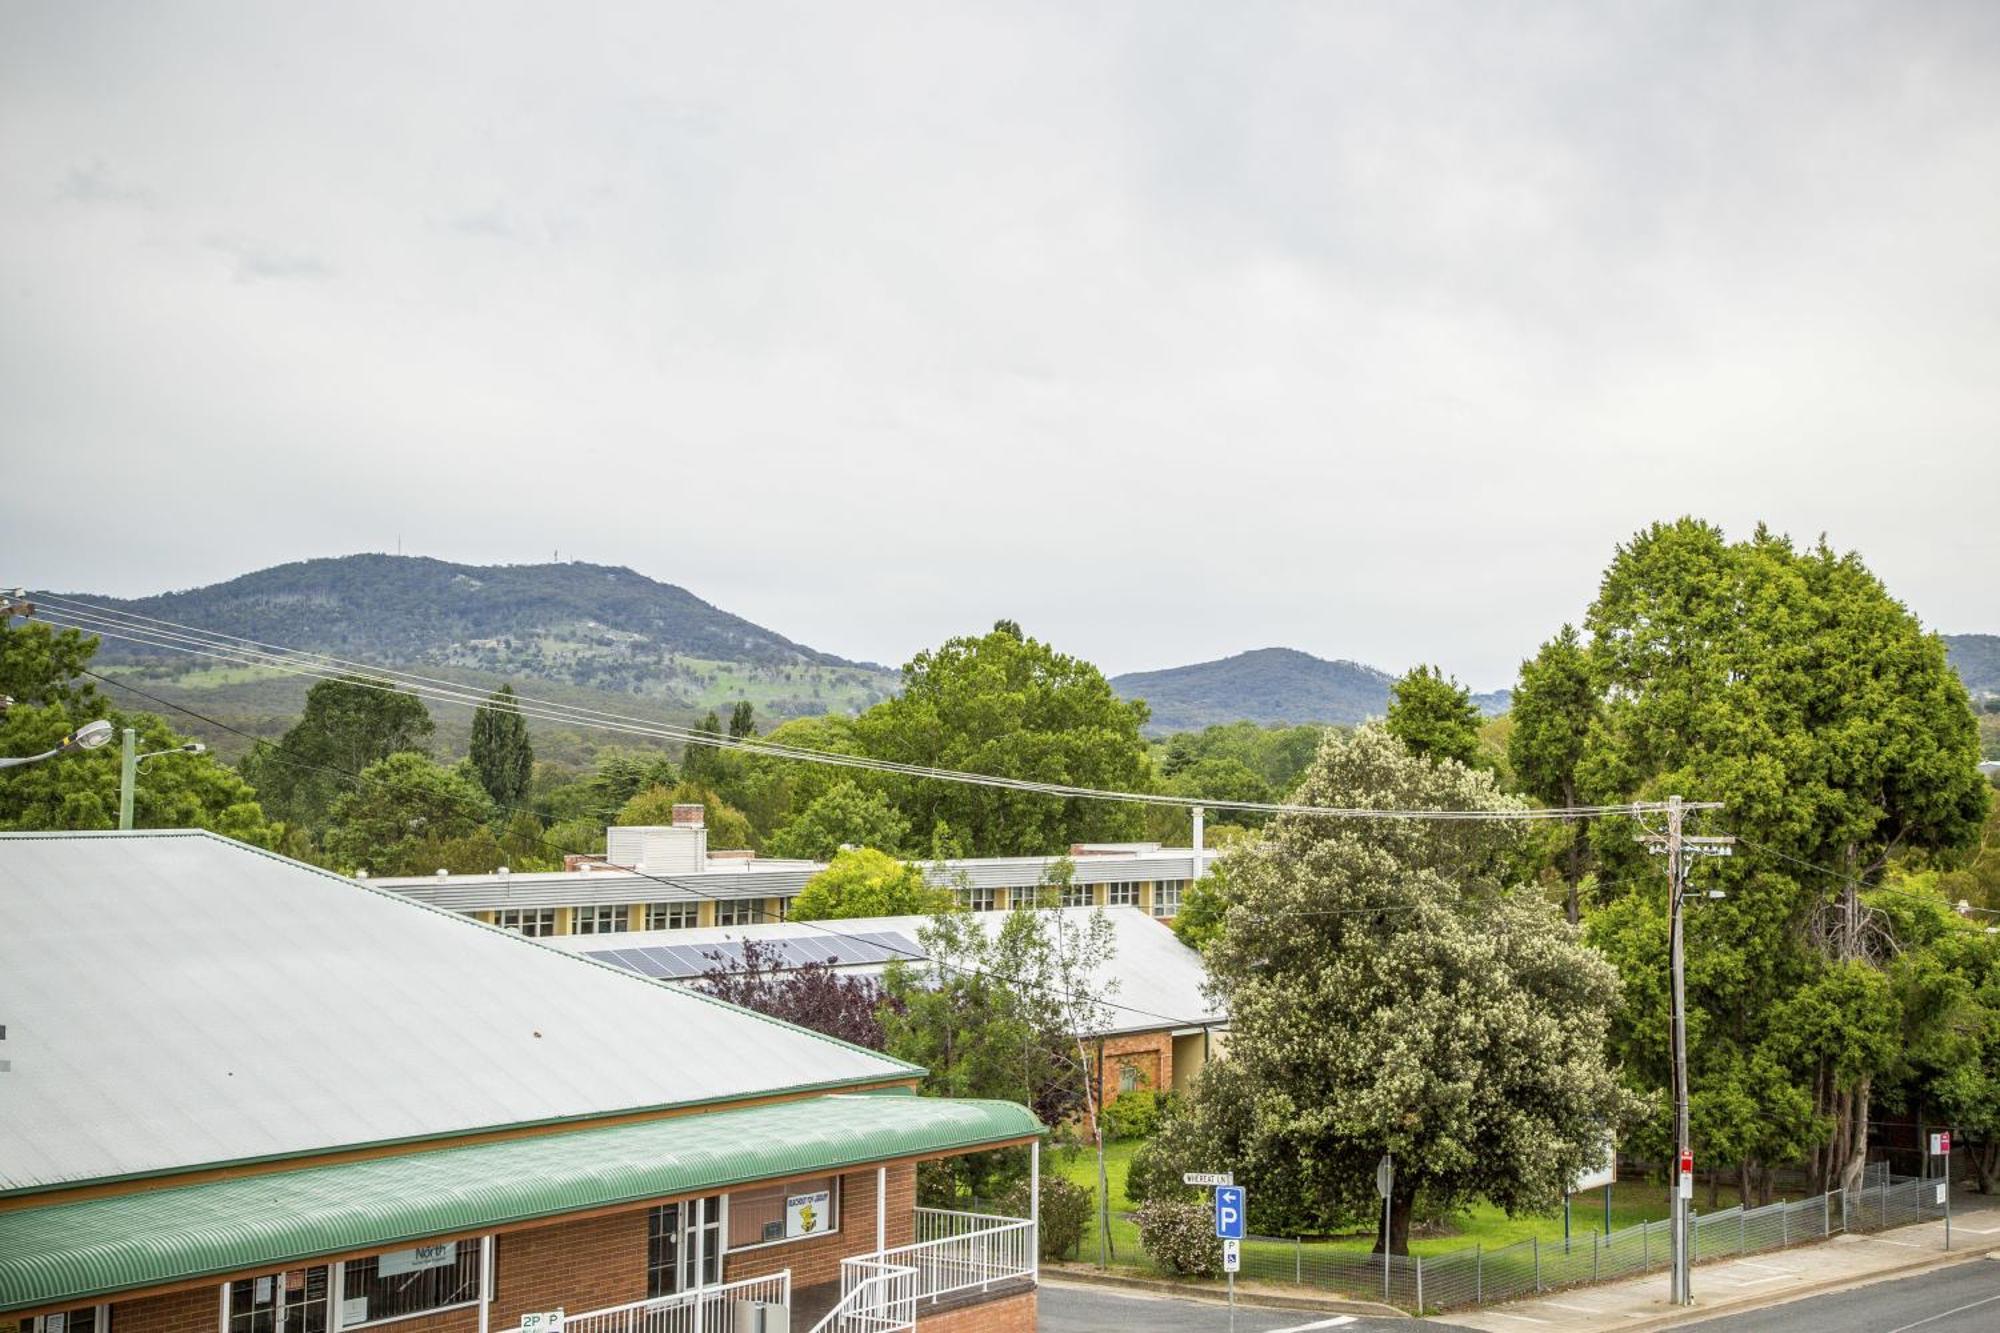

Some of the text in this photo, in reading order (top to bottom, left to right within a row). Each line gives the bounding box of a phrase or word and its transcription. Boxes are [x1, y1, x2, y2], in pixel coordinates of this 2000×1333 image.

[1221, 1207, 1238, 1232] P
[1229, 1241, 1236, 1249] P
[415, 1243, 447, 1260] North
[523, 1316, 540, 1327] 2P
[549, 1314, 558, 1325] P
